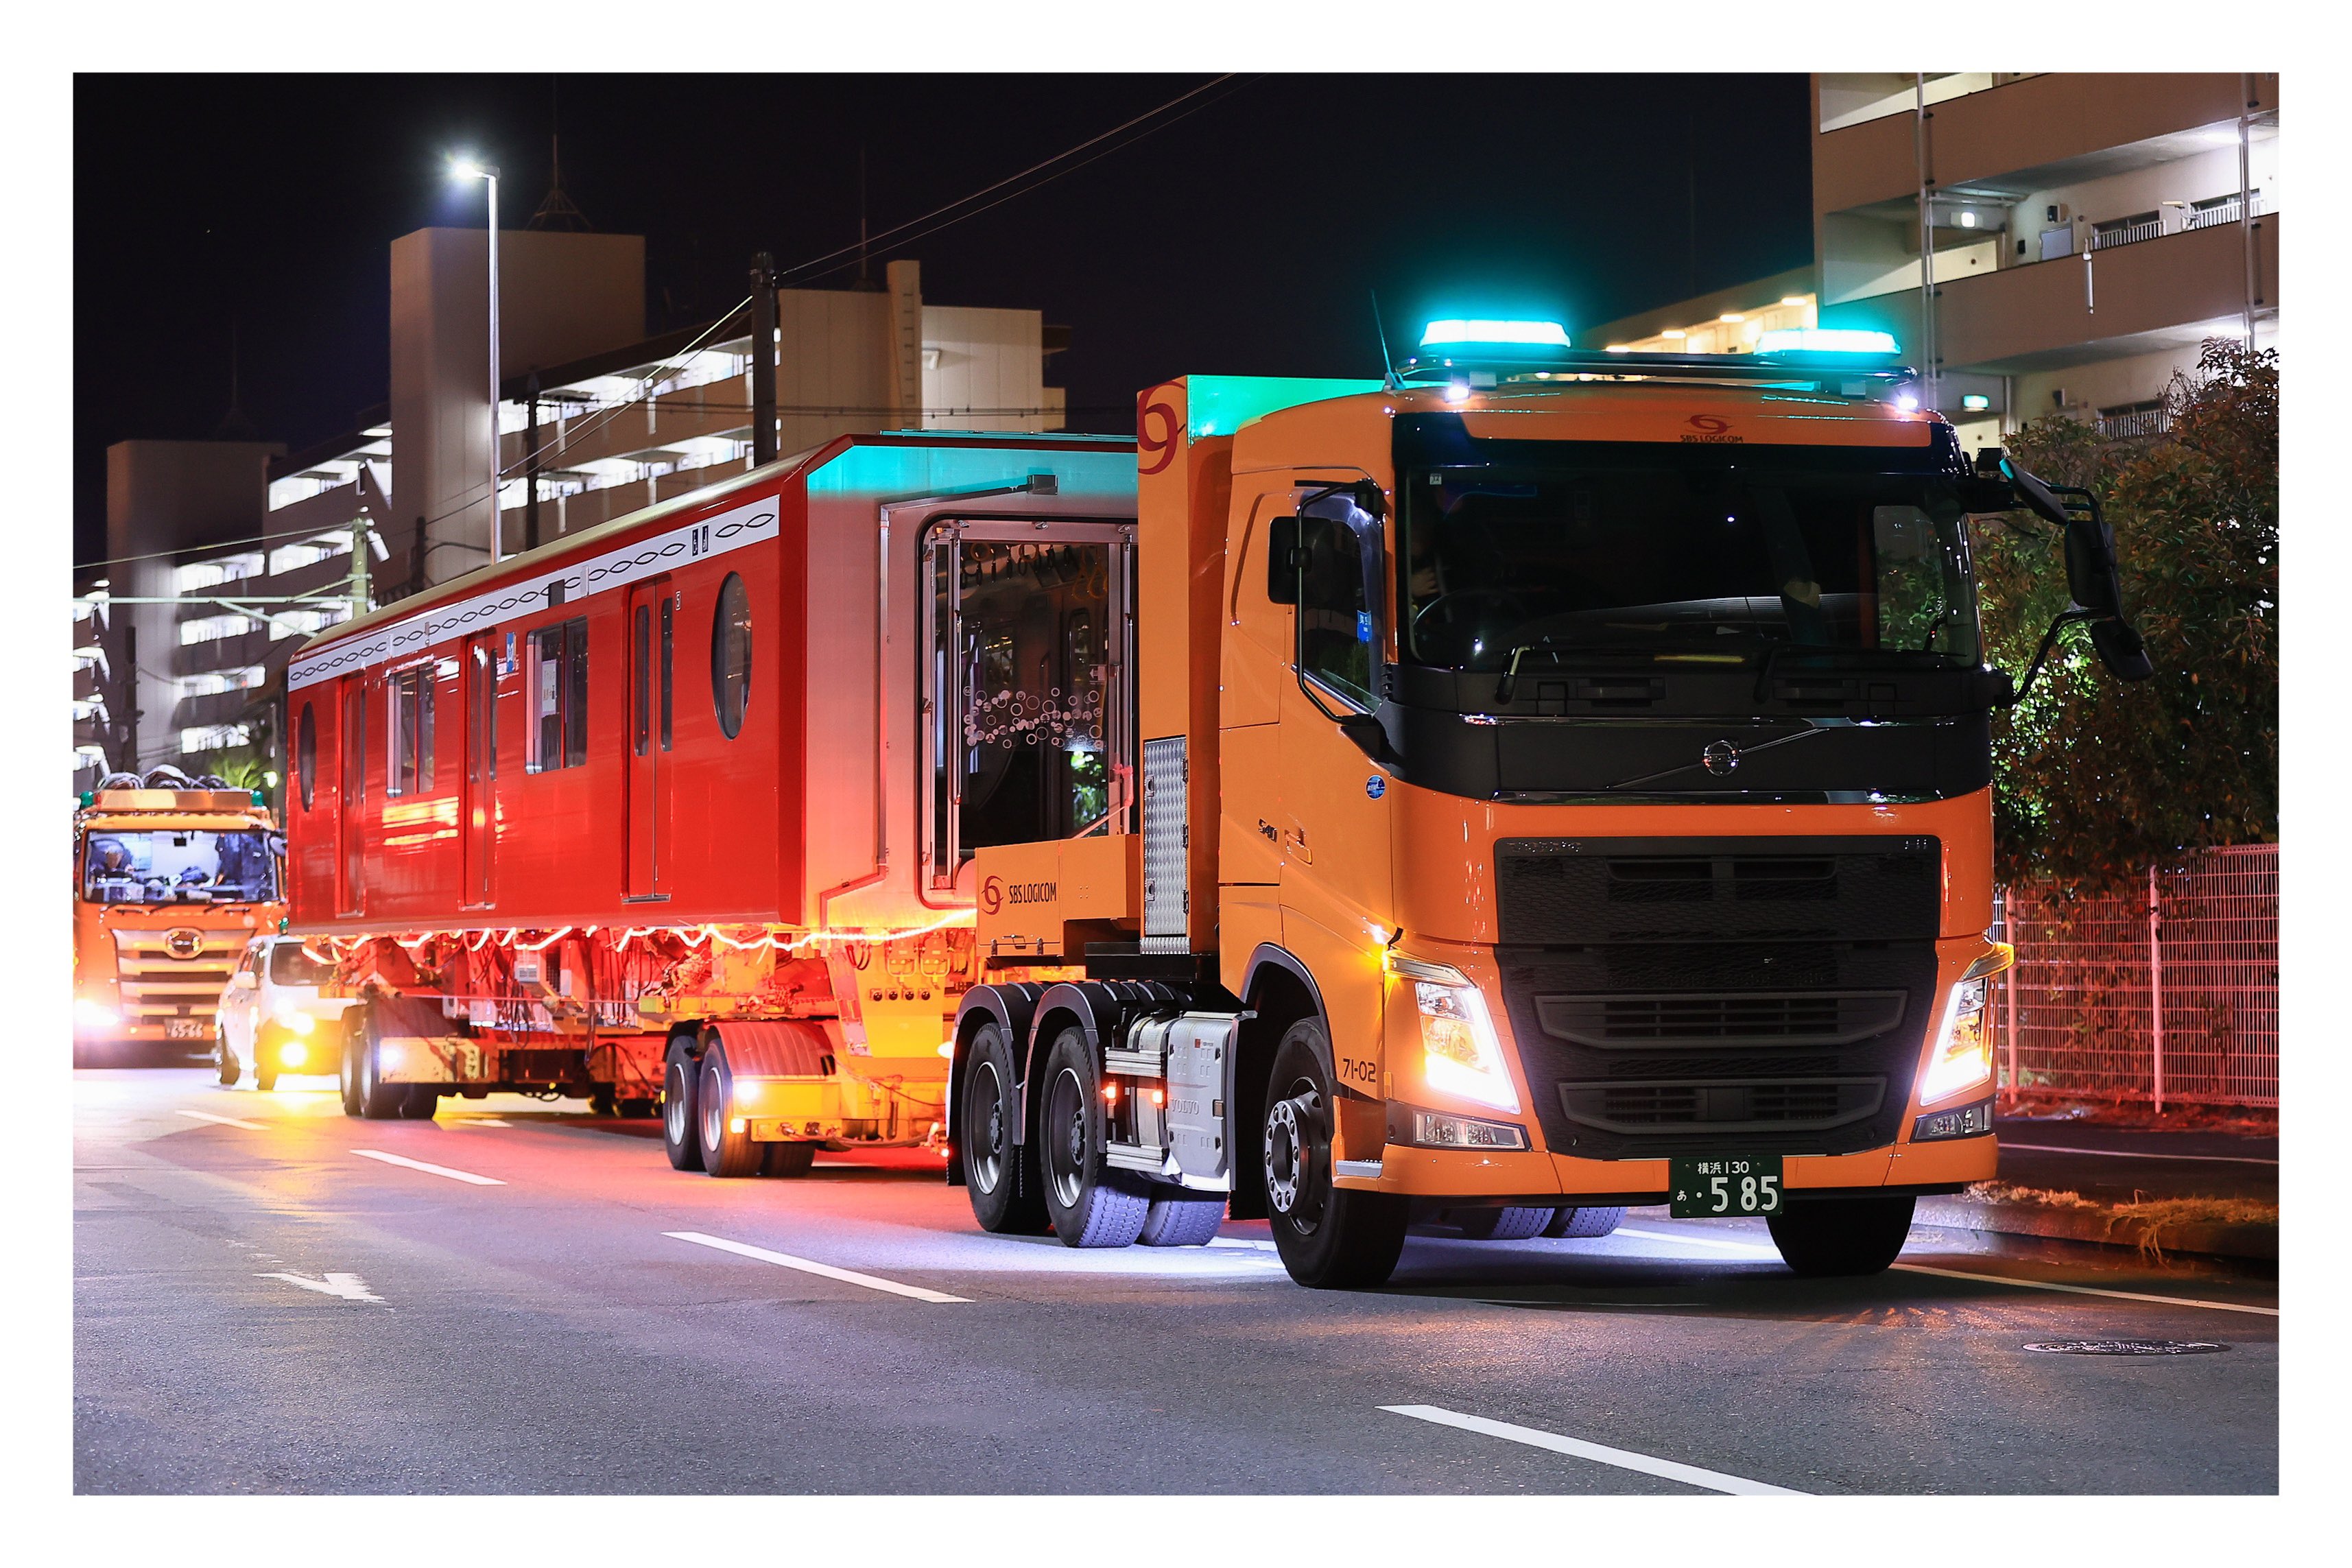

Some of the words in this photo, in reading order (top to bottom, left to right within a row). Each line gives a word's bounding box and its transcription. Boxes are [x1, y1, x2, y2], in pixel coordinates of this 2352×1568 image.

[1700, 435, 1744, 443] LOGICOM
[1009, 884, 1022, 904] SBS
[1023, 882, 1056, 903] LOGICOM
[1343, 1058, 1376, 1082] 71-02
[1170, 1098, 1200, 1115] VOLVO
[1676, 1189, 1687, 1201] あ
